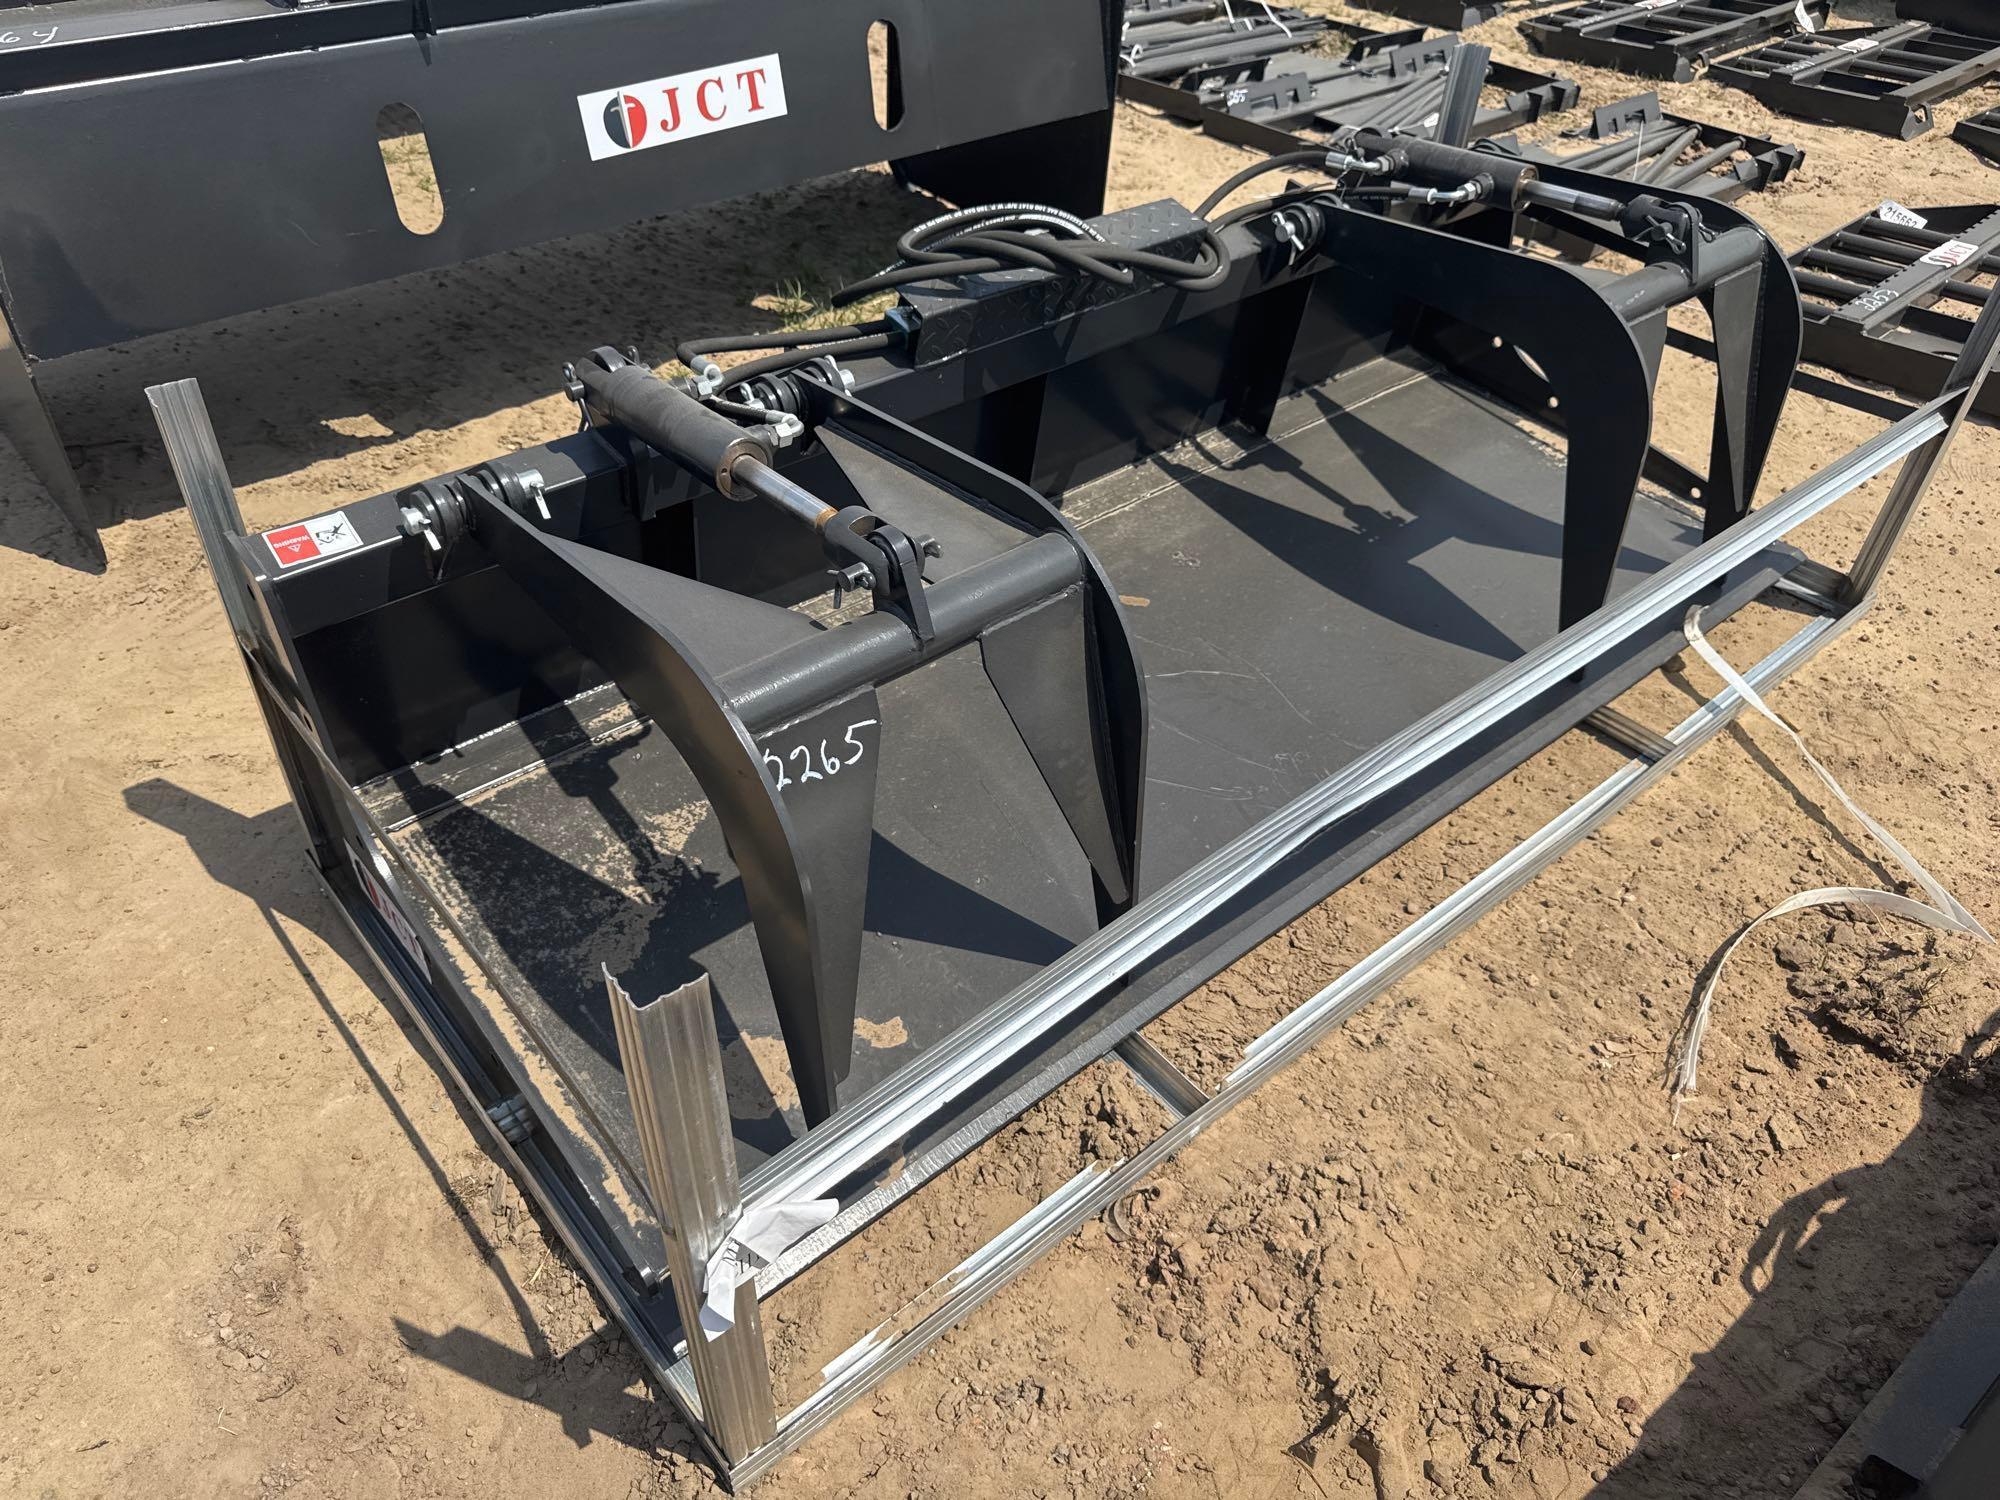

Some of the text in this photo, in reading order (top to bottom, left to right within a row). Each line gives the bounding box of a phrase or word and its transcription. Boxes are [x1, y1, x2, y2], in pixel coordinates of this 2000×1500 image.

[0, 26, 58, 44] 64
[660, 69, 766, 132] JCT
[273, 534, 310, 549] WARNING
[763, 719, 877, 791] 2265
